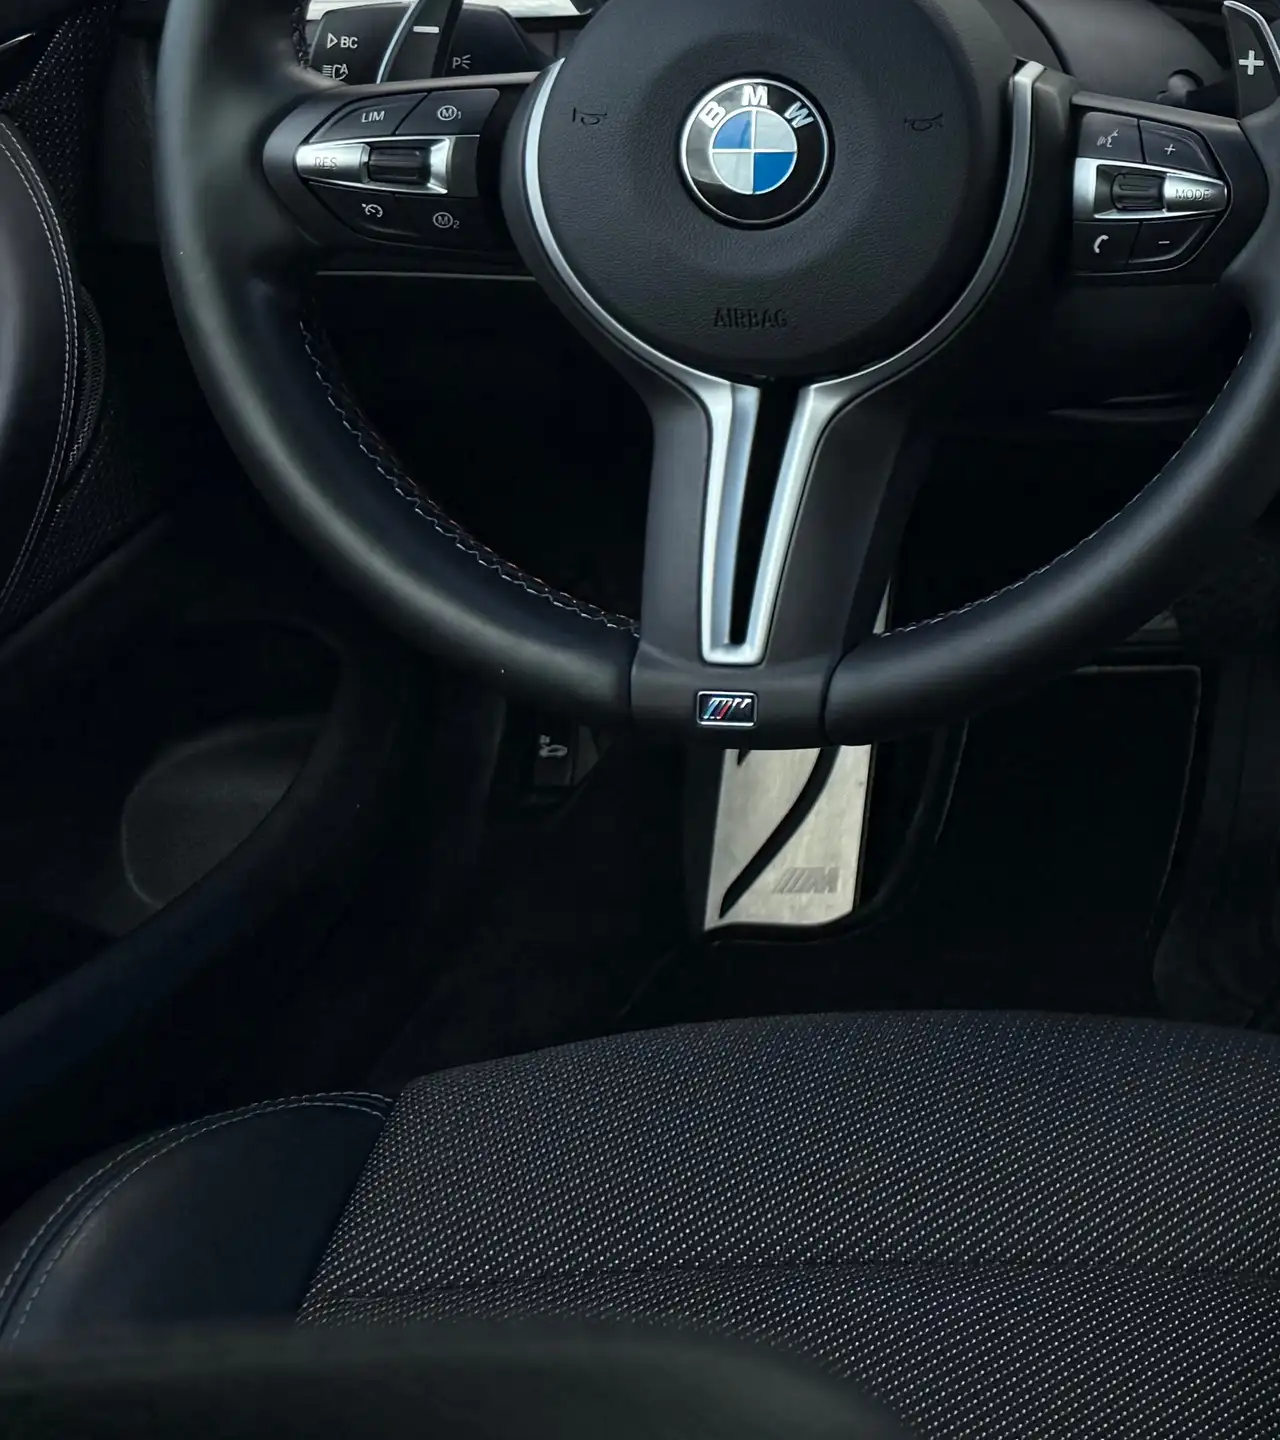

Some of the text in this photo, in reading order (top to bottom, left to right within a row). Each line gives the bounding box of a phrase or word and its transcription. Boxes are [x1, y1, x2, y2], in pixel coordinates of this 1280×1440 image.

[340, 36, 358, 49] BC
[699, 84, 815, 129] BMW
[361, 110, 385, 123] LIM
[314, 156, 338, 169] RES
[1175, 187, 1211, 201] MODE
[713, 308, 787, 329] AIRBAG
